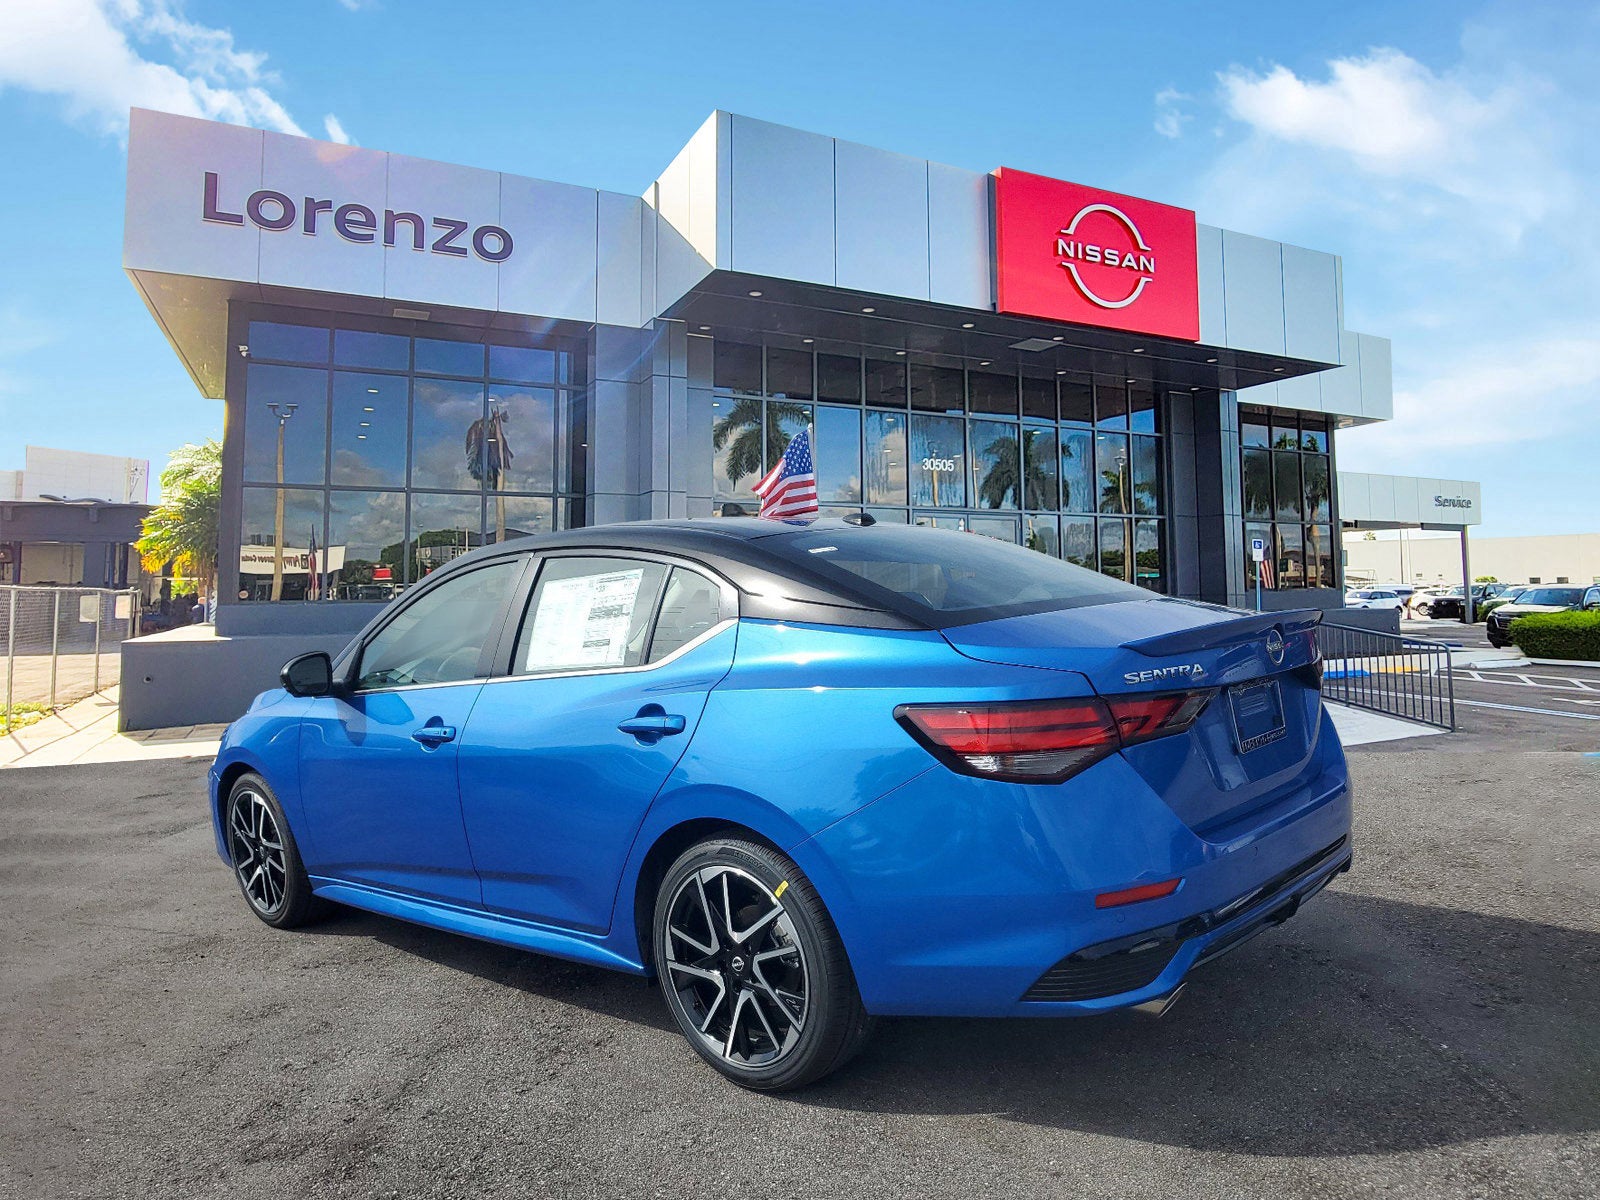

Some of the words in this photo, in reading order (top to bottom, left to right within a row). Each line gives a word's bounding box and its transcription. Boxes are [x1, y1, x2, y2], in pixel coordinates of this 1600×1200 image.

[202, 171, 514, 262] Lorenzo
[1058, 238, 1155, 273] NISSAN
[922, 457, 955, 472] 30505
[1434, 495, 1472, 508] Service
[1124, 663, 1204, 685] SENTRA
